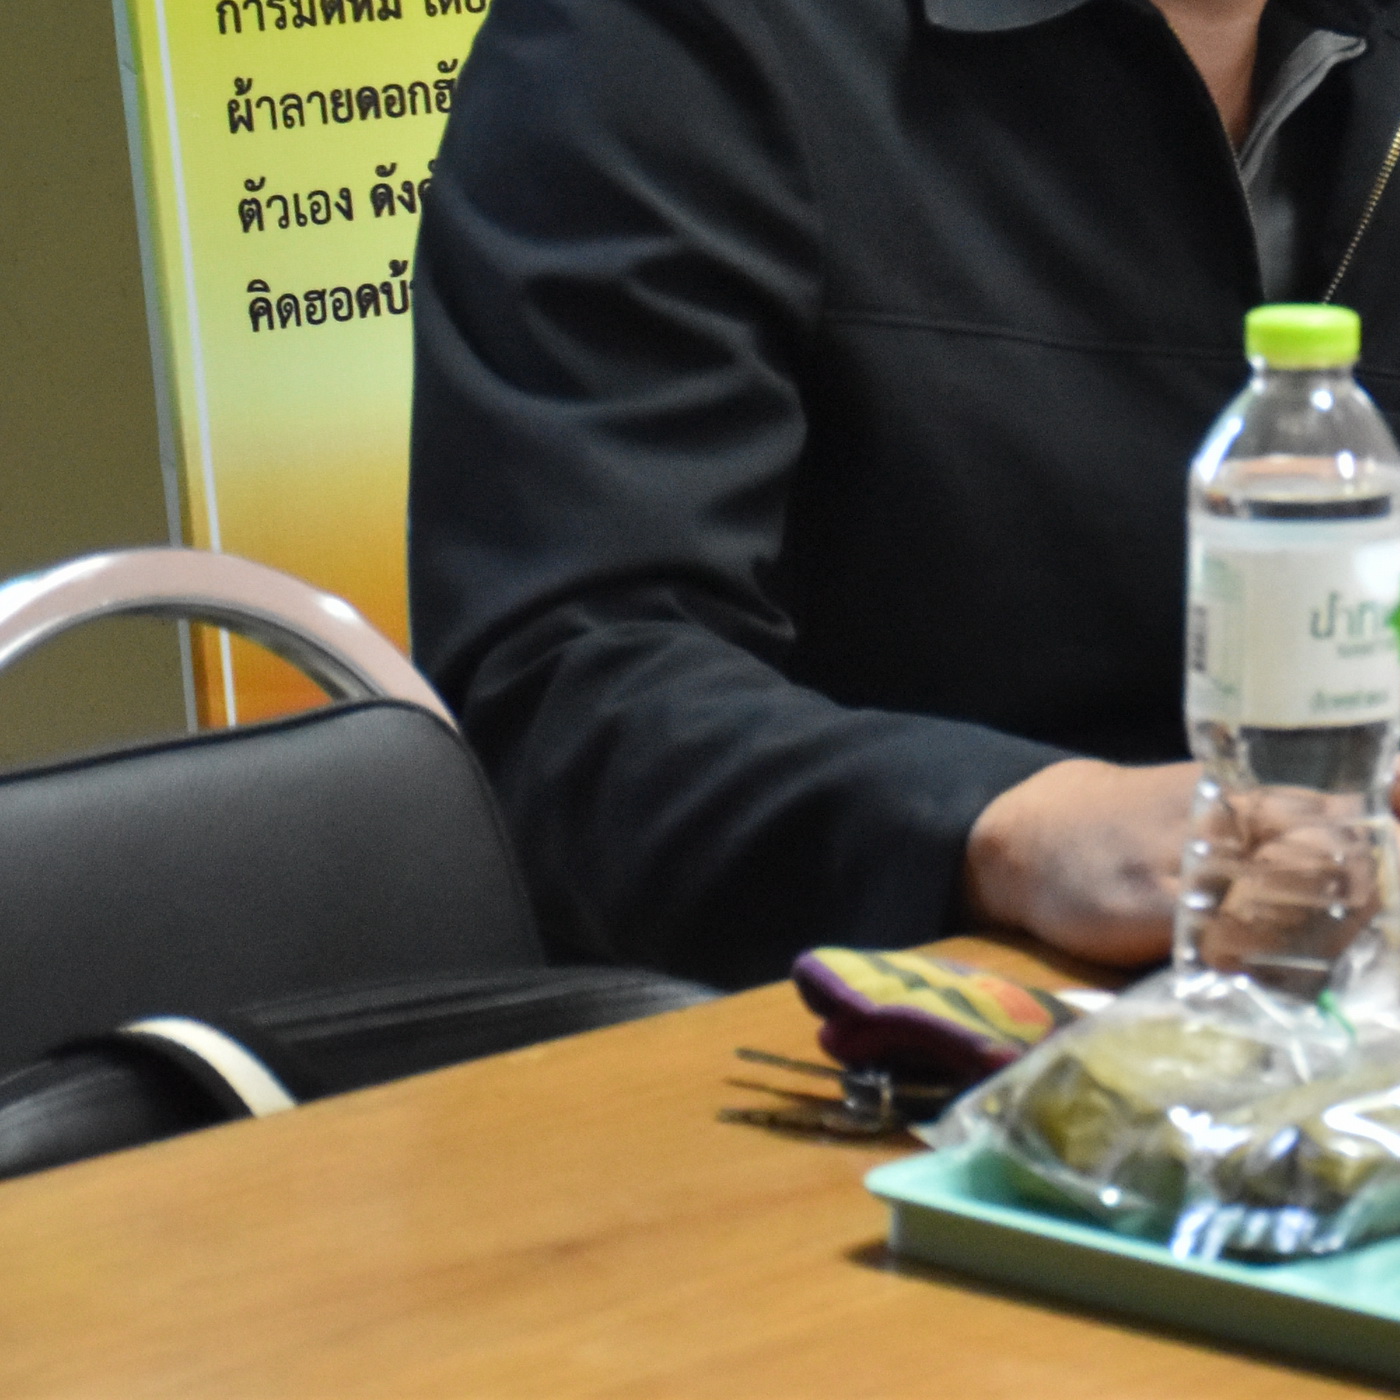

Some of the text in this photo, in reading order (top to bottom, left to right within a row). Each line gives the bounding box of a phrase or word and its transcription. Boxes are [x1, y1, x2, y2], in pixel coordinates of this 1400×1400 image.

[237, 175, 354, 234] ตัวเอง
[245, 258, 414, 333] คิดฮอดบ้
